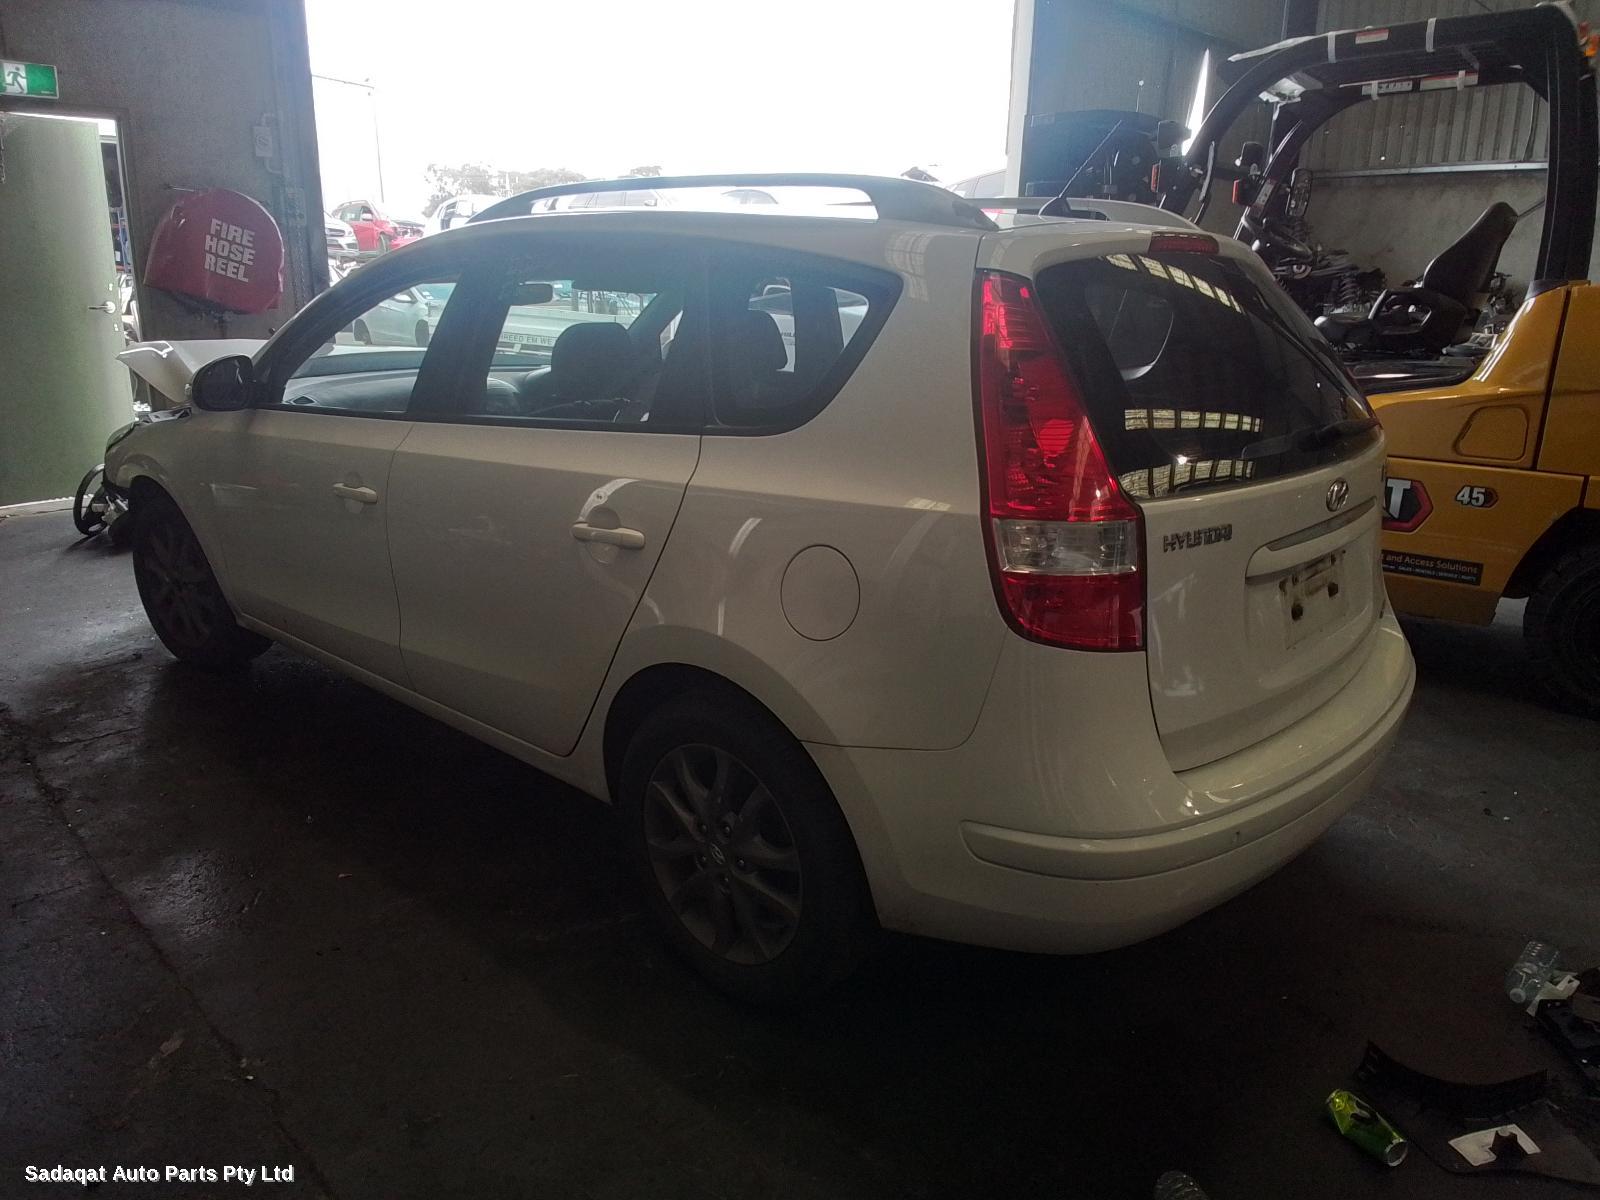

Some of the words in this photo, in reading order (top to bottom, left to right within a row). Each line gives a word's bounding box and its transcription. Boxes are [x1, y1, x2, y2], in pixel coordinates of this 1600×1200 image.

[210, 218, 256, 247] FIRE
[204, 234, 256, 265] HOSE
[204, 252, 249, 282] REEL
[1456, 486, 1486, 506] 45
[1385, 553, 1403, 562] and
[1404, 556, 1435, 568] Access
[1436, 559, 1478, 574] Solutions
